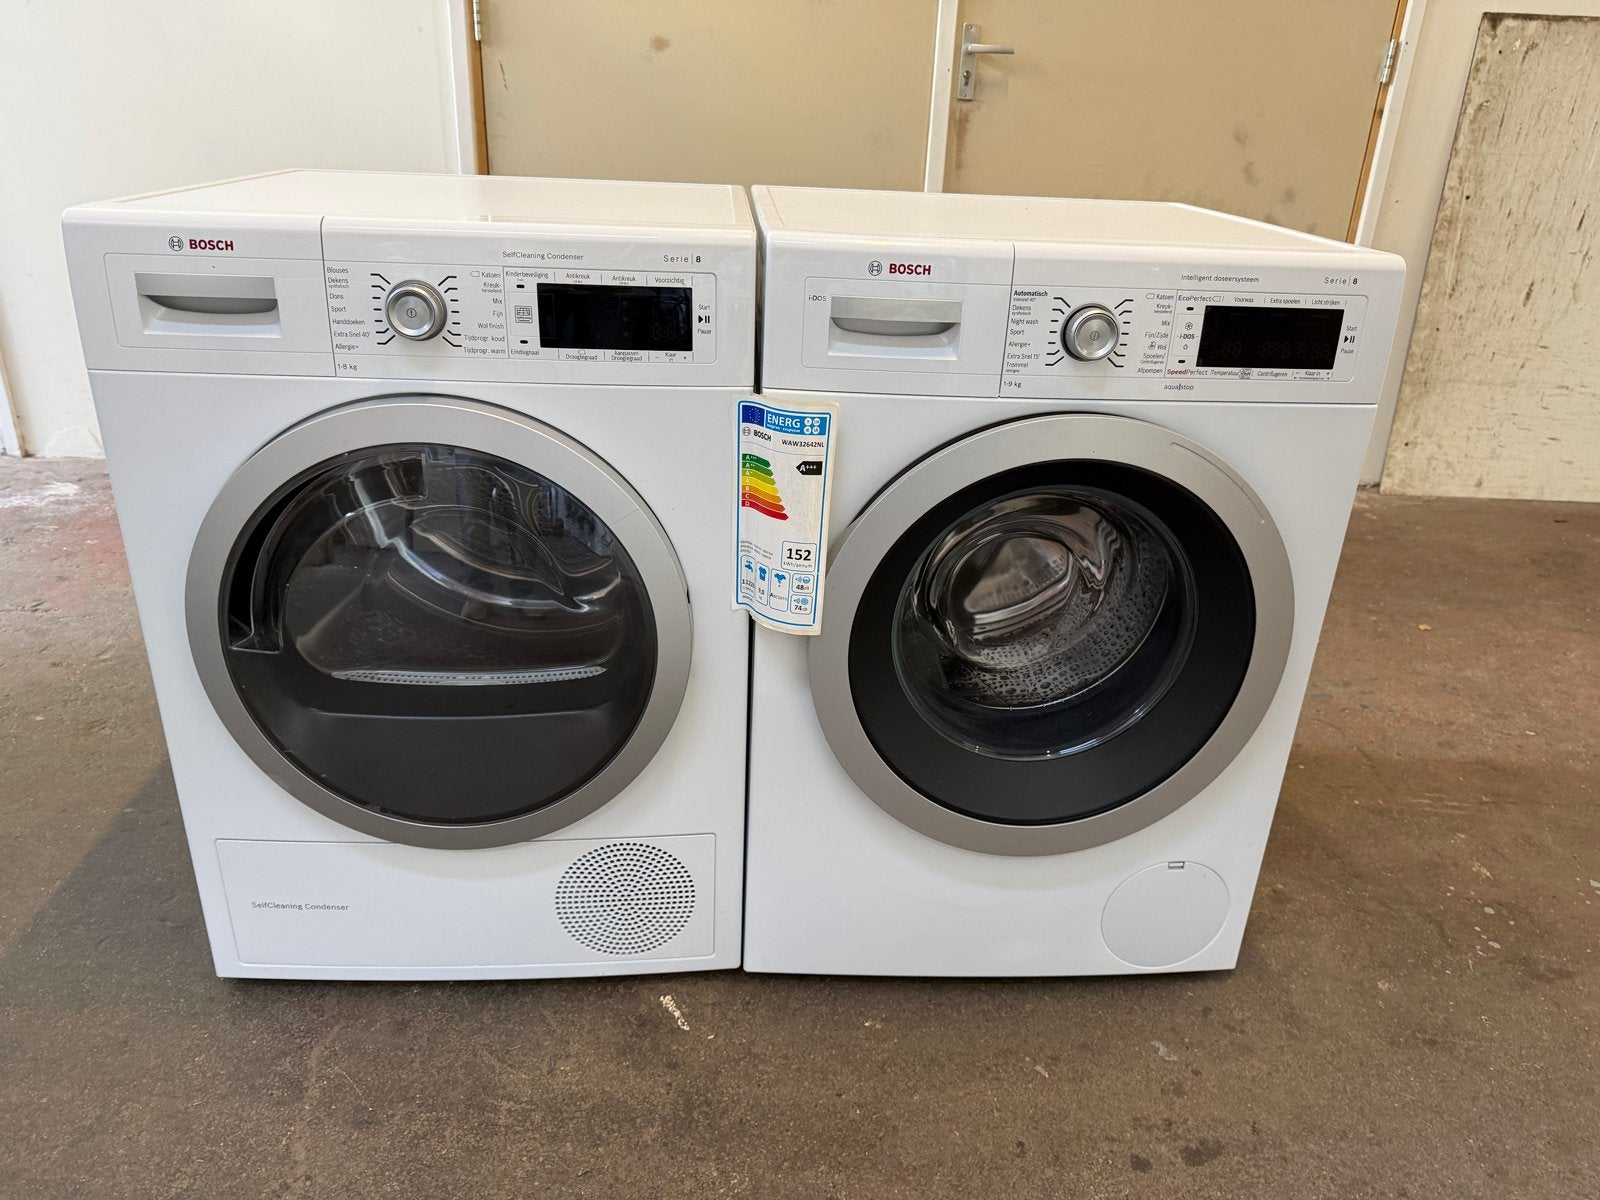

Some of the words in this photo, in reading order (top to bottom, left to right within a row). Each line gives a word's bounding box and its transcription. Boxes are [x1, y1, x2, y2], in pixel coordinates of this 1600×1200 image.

[189, 239, 234, 251] BOSCH
[502, 251, 545, 260] SelfCleaning
[547, 252, 584, 261] Condenser
[663, 254, 689, 263] Serie
[695, 255, 702, 263] 8
[326, 266, 349, 274] Blouses
[889, 263, 932, 276] BOSCH
[328, 276, 349, 284] Dekens
[565, 272, 591, 280] Antikreuk
[1181, 274, 1212, 282] Intelligent
[1213, 275, 1260, 284] doseersysteem
[655, 276, 685, 285] Voorzichtig
[1324, 276, 1347, 285] Serie
[1352, 277, 1358, 285] 8
[329, 292, 344, 300] Dons
[1013, 289, 1048, 297] Automatisch
[1178, 294, 1211, 302] EcoPerfect
[330, 305, 347, 313] Sport
[1010, 318, 1025, 326] Night
[333, 330, 348, 338] Extra
[1009, 328, 1025, 336] Sport
[335, 343, 359, 351] Allergie+
[1008, 341, 1031, 349] Allergie+
[510, 348, 540, 356] Eindsignaal
[1006, 352, 1021, 360] Extra
[349, 363, 358, 371] kg
[1136, 367, 1163, 375] Afpompen
[1166, 368, 1208, 376] SpeedPerfect
[1013, 381, 1022, 389] kg
[767, 413, 801, 429] ENERG
[753, 429, 772, 441] BOSCH
[782, 439, 825, 448] WAW32642NL
[800, 464, 817, 472] A+++
[786, 547, 812, 562] 152
[251, 901, 303, 911] SelfCleaning
[304, 903, 349, 911] Condenser
